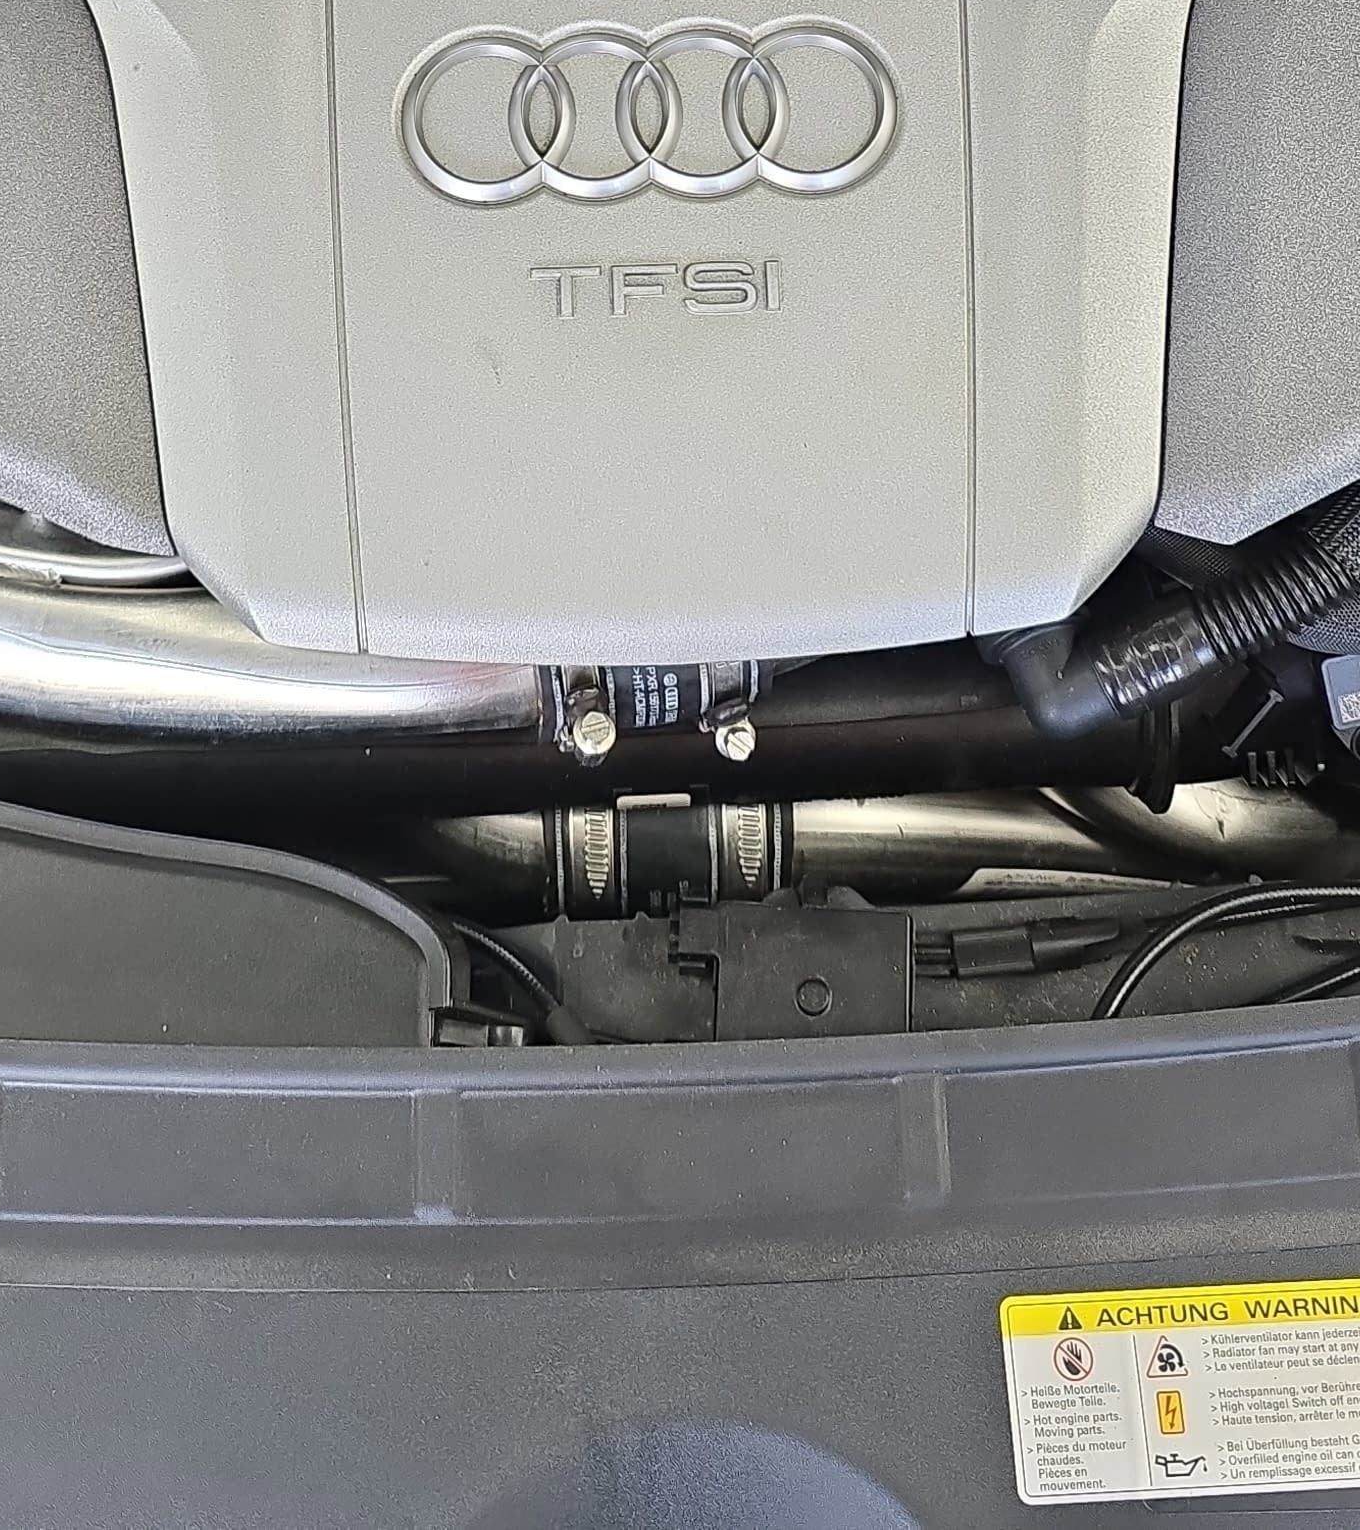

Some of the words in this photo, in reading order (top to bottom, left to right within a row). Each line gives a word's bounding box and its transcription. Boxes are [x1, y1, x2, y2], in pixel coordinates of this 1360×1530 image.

[530, 259, 783, 318] TFSI
[1096, 1302, 1229, 1327] ACHTUNG
[1211, 1331, 1292, 1345] Kühlerventilator
[1295, 1330, 1320, 1341] kann
[1213, 1346, 1256, 1358] Radiator
[1259, 1346, 1275, 1356] fan
[1278, 1345, 1300, 1358] may
[1303, 1343, 1325, 1354] start
[1328, 1341, 1338, 1351] at
[1341, 1340, 1360, 1353] any
[1214, 1361, 1226, 1371] Le
[1229, 1359, 1284, 1371] ventilateur
[1287, 1358, 1309, 1370] peut
[1312, 1359, 1325, 1367] se
[1031, 1384, 1061, 1397] Heiße
[1064, 1382, 1120, 1394] Motorteile.
[1218, 1386, 1296, 1400] Hochspannung,
[1301, 1385, 1317, 1394] vor
[1031, 1398, 1076, 1411] Bewegte
[1079, 1395, 1106, 1407] Teile.
[1220, 1401, 1244, 1414] High
[1292, 1397, 1327, 1409] Switch
[1329, 1395, 1344, 1406] off
[1033, 1414, 1050, 1425] Hot
[1054, 1414, 1090, 1427] engine
[1092, 1411, 1122, 1423] parts.
[1222, 1414, 1252, 1426] Haute
[1255, 1412, 1297, 1426] tension,
[1300, 1409, 1333, 1422] arrêter
[1336, 1408, 1346, 1418] le
[1035, 1426, 1074, 1439] Moving
[1077, 1424, 1105, 1437] parts.
[1036, 1442, 1069, 1454] Pièces
[1072, 1442, 1086, 1452] du
[1089, 1440, 1126, 1451] moteur
[1227, 1441, 1244, 1452] Bei
[1246, 1438, 1308, 1453] Überfüllung
[1311, 1434, 1349, 1449] besteht
[1037, 1455, 1084, 1466] chaudes.
[1228, 1453, 1279, 1466] Overfilled
[1282, 1453, 1317, 1466] engine
[1320, 1450, 1333, 1461] oil
[1335, 1450, 1353, 1460] can
[1039, 1467, 1072, 1479] Pièces
[1074, 1467, 1087, 1476] en
[1230, 1468, 1246, 1479] Un
[1249, 1465, 1311, 1480] remplissage
[1315, 1462, 1356, 1476] excessif
[1040, 1478, 1106, 1491] mouvement.
